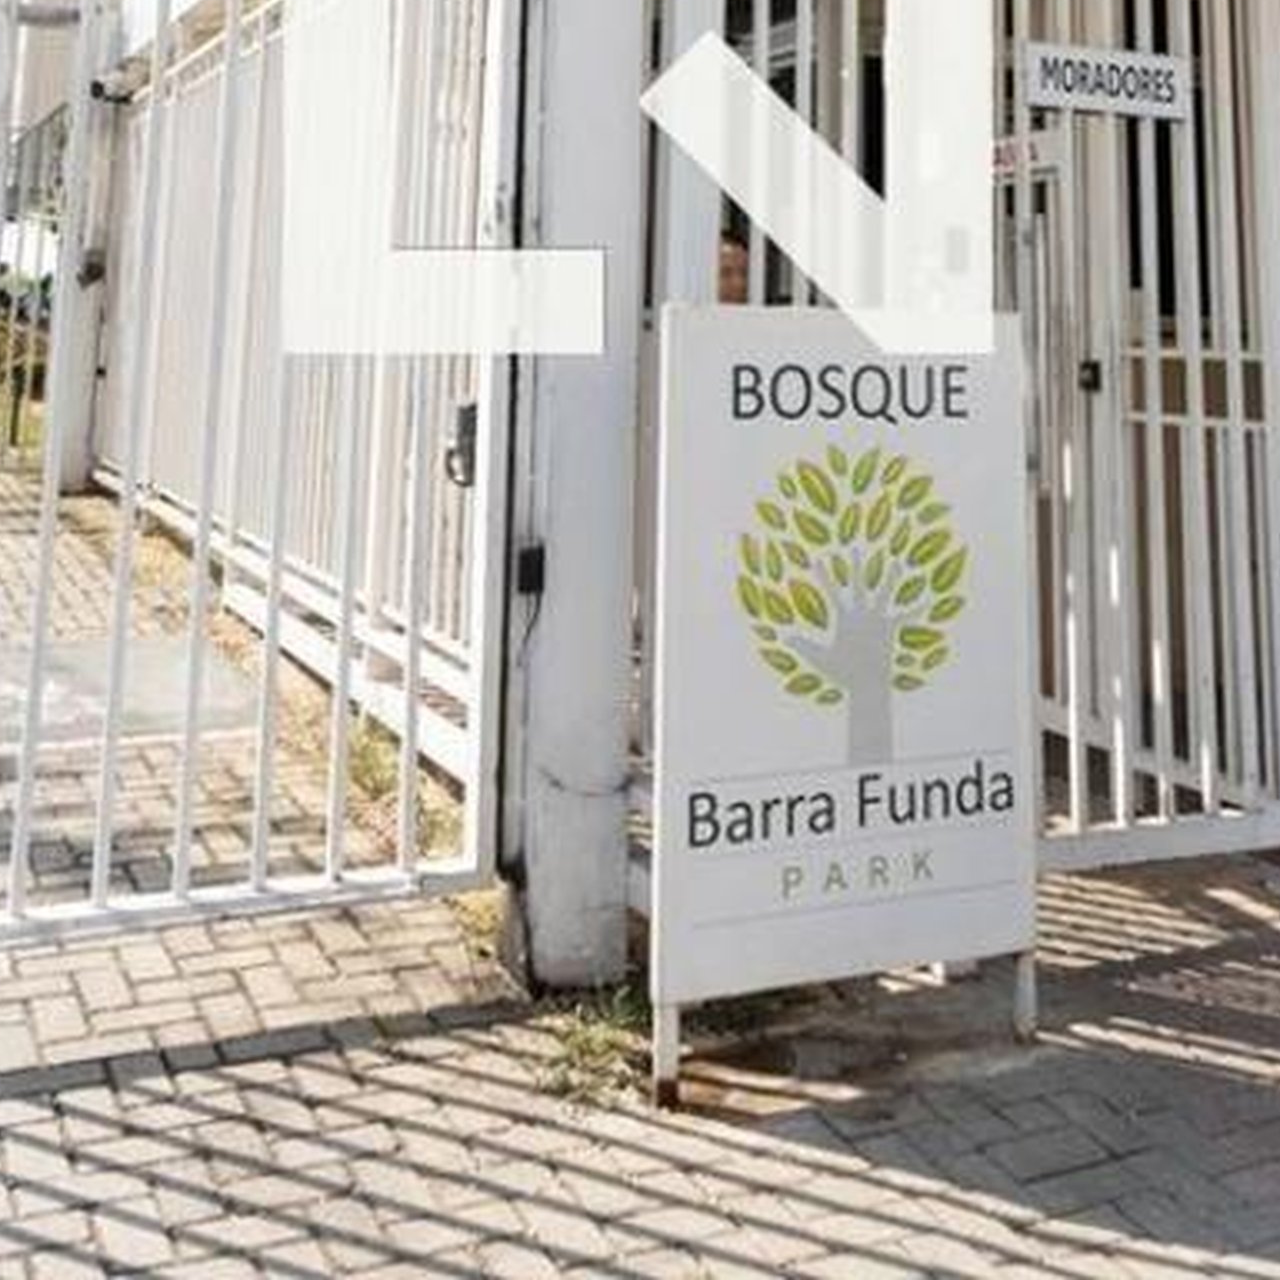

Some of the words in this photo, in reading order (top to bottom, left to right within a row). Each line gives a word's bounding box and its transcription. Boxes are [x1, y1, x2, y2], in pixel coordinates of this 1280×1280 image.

[1039, 56, 1177, 104] MORADORES
[731, 363, 971, 425] BOSQUE
[687, 786, 837, 849] Barra
[857, 759, 1016, 828] Funda
[781, 848, 935, 901] PARK
